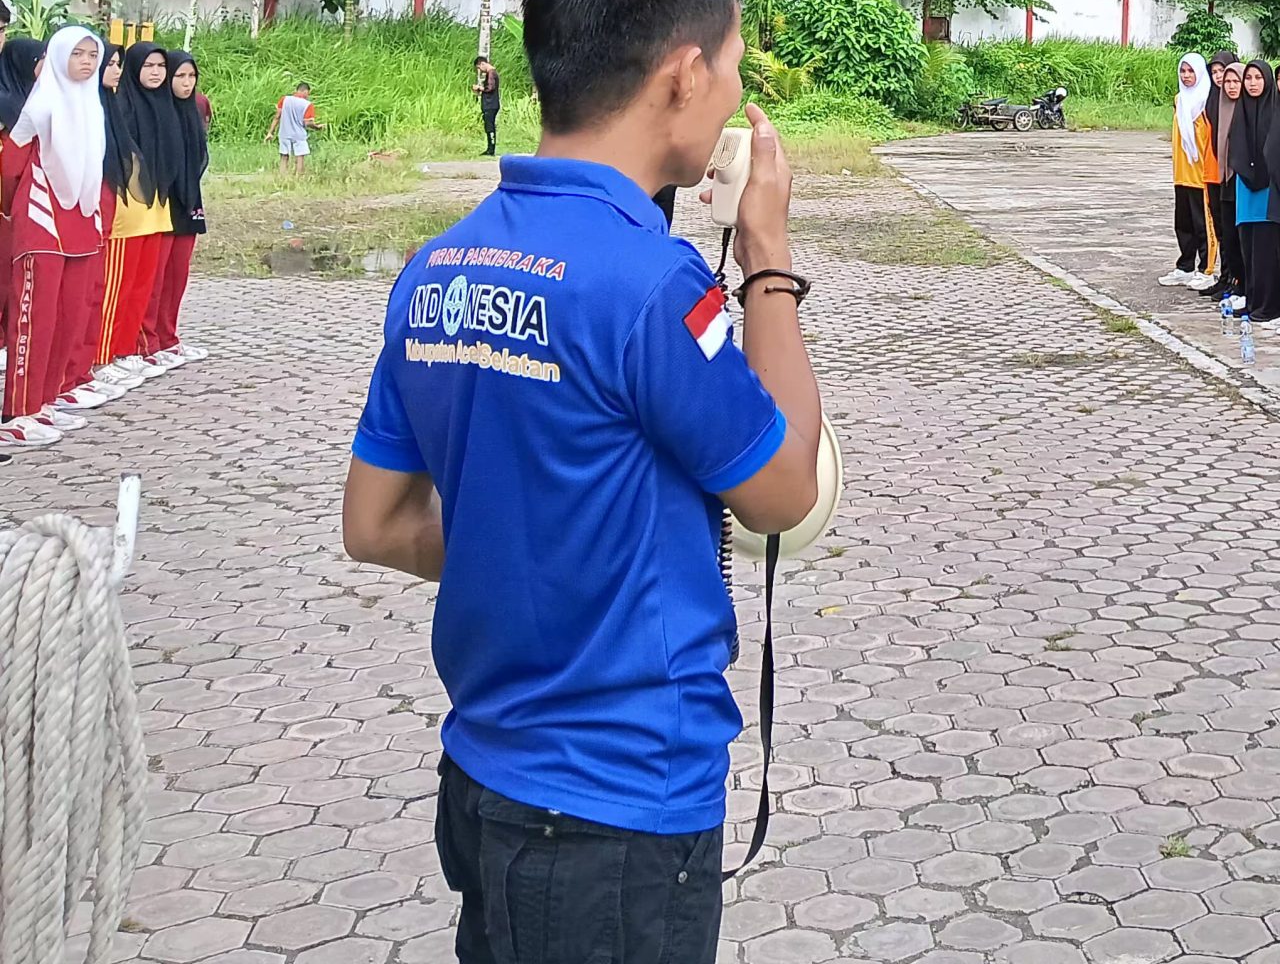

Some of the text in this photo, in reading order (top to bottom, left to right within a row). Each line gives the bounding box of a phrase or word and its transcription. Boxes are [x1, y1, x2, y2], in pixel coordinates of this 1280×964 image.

[462, 247, 566, 281] PASKIBRAKA
[408, 275, 549, 346] INDONESIA
[17, 335, 27, 376] 2024
[478, 343, 561, 382] Selatan
